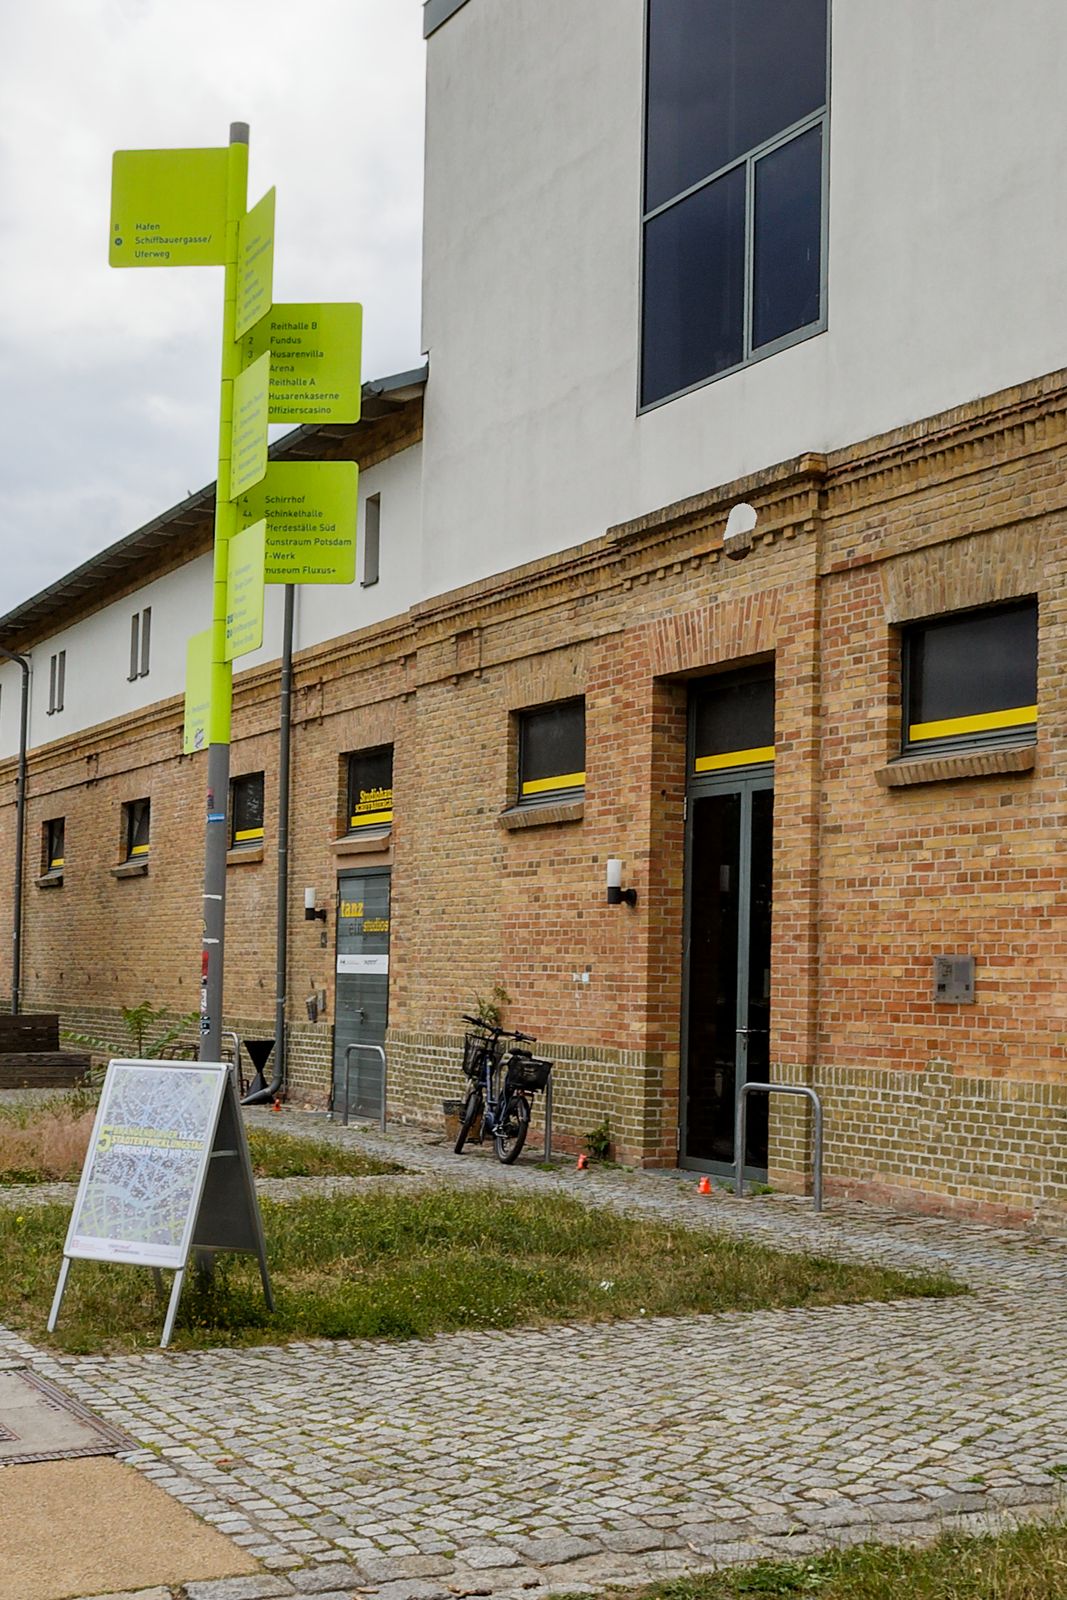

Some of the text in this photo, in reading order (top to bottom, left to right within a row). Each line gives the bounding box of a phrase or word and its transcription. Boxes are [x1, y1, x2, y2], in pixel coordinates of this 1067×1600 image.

[135, 223, 161, 231] Hafen
[135, 235, 212, 245] Schiffbauergasse/
[134, 251, 170, 259] Uferweg
[270, 322, 318, 330] Reithalle B
[248, 336, 302, 345] 2 Fundus
[270, 350, 324, 358] Husarenvilla
[269, 378, 316, 386] Reithalle A
[268, 392, 340, 400] Husarenkaserne
[268, 406, 332, 414] Offizierscasino
[265, 495, 306, 503] Schirrhof
[264, 509, 323, 518] Schinkelhalle
[319, 523, 336, 532] Süd
[314, 537, 352, 546] Potsdam
[302, 565, 336, 574] Fluxus+
[341, 900, 364, 917] tanz
